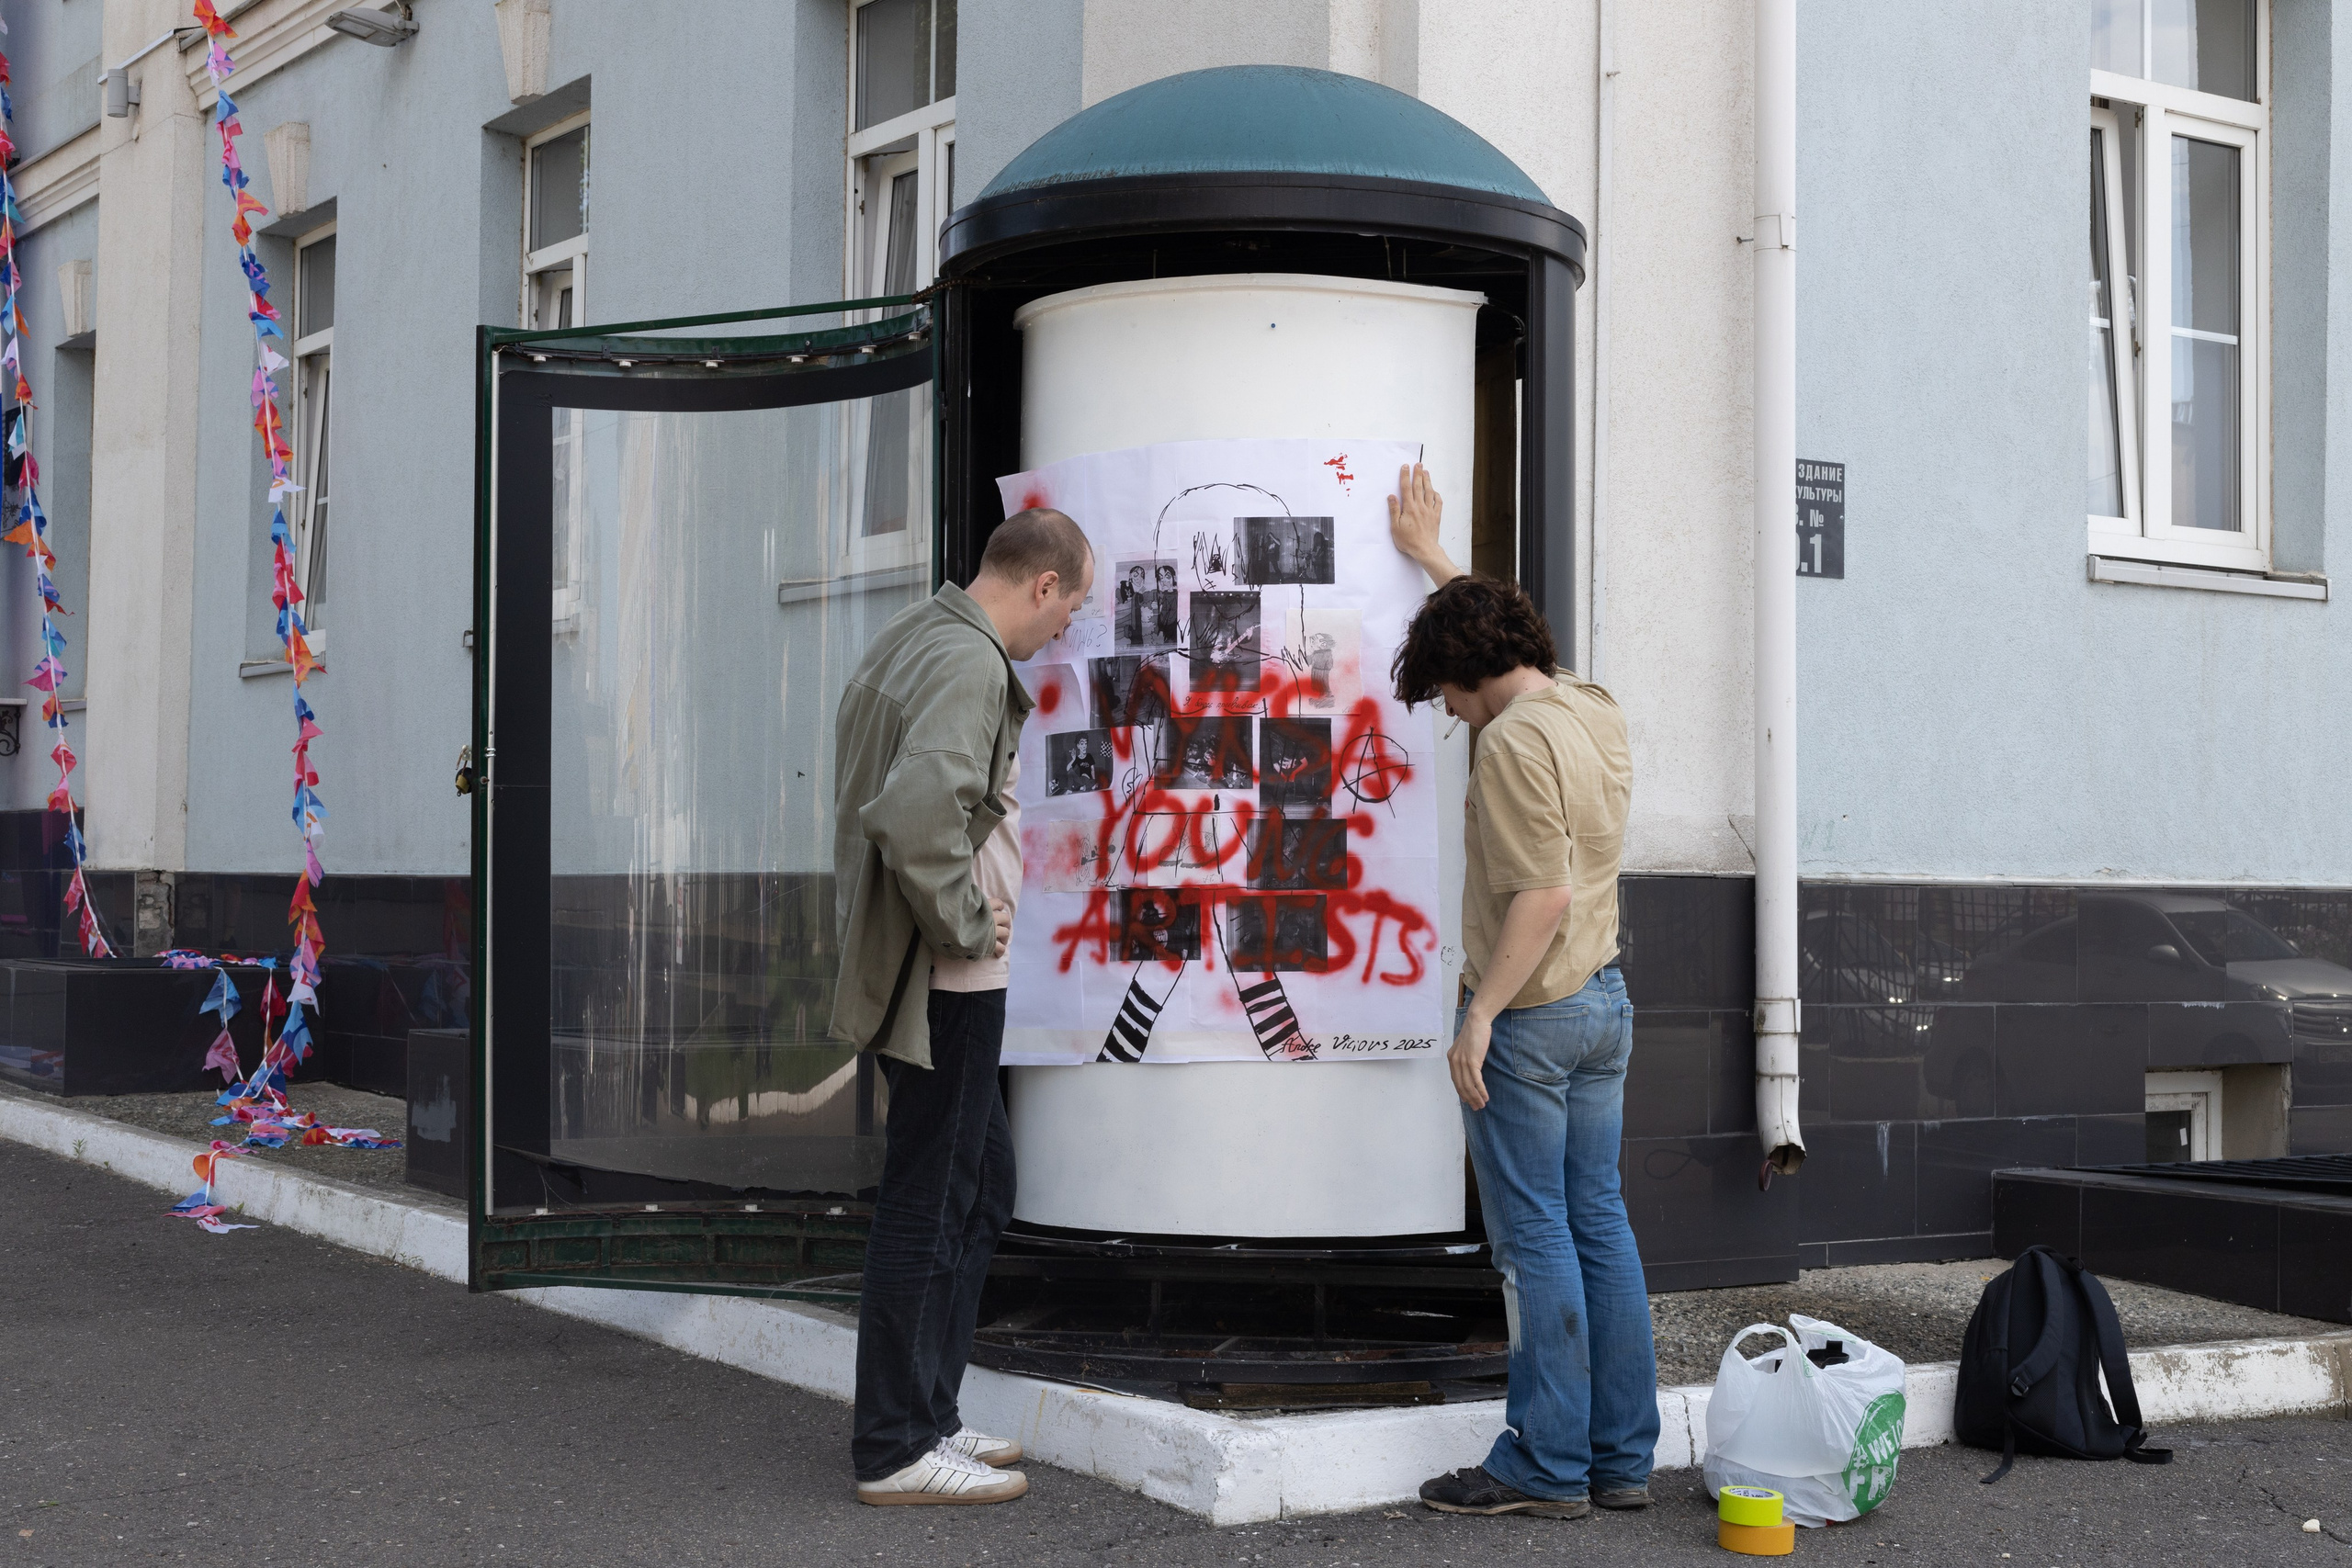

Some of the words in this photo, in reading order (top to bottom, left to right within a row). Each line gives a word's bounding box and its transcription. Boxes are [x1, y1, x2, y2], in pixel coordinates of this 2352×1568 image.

[1798, 463, 1843, 482] ЗДАНИЕ
[1795, 485, 1842, 502] УЛЬТУРЫ
[1809, 509, 1825, 527] №
[1095, 773, 1375, 890] YOUNG
[1053, 880, 1440, 987] ARTISTS
[1332, 1033, 1388, 1052] Vicious
[1393, 1039, 1438, 1051] 2025
